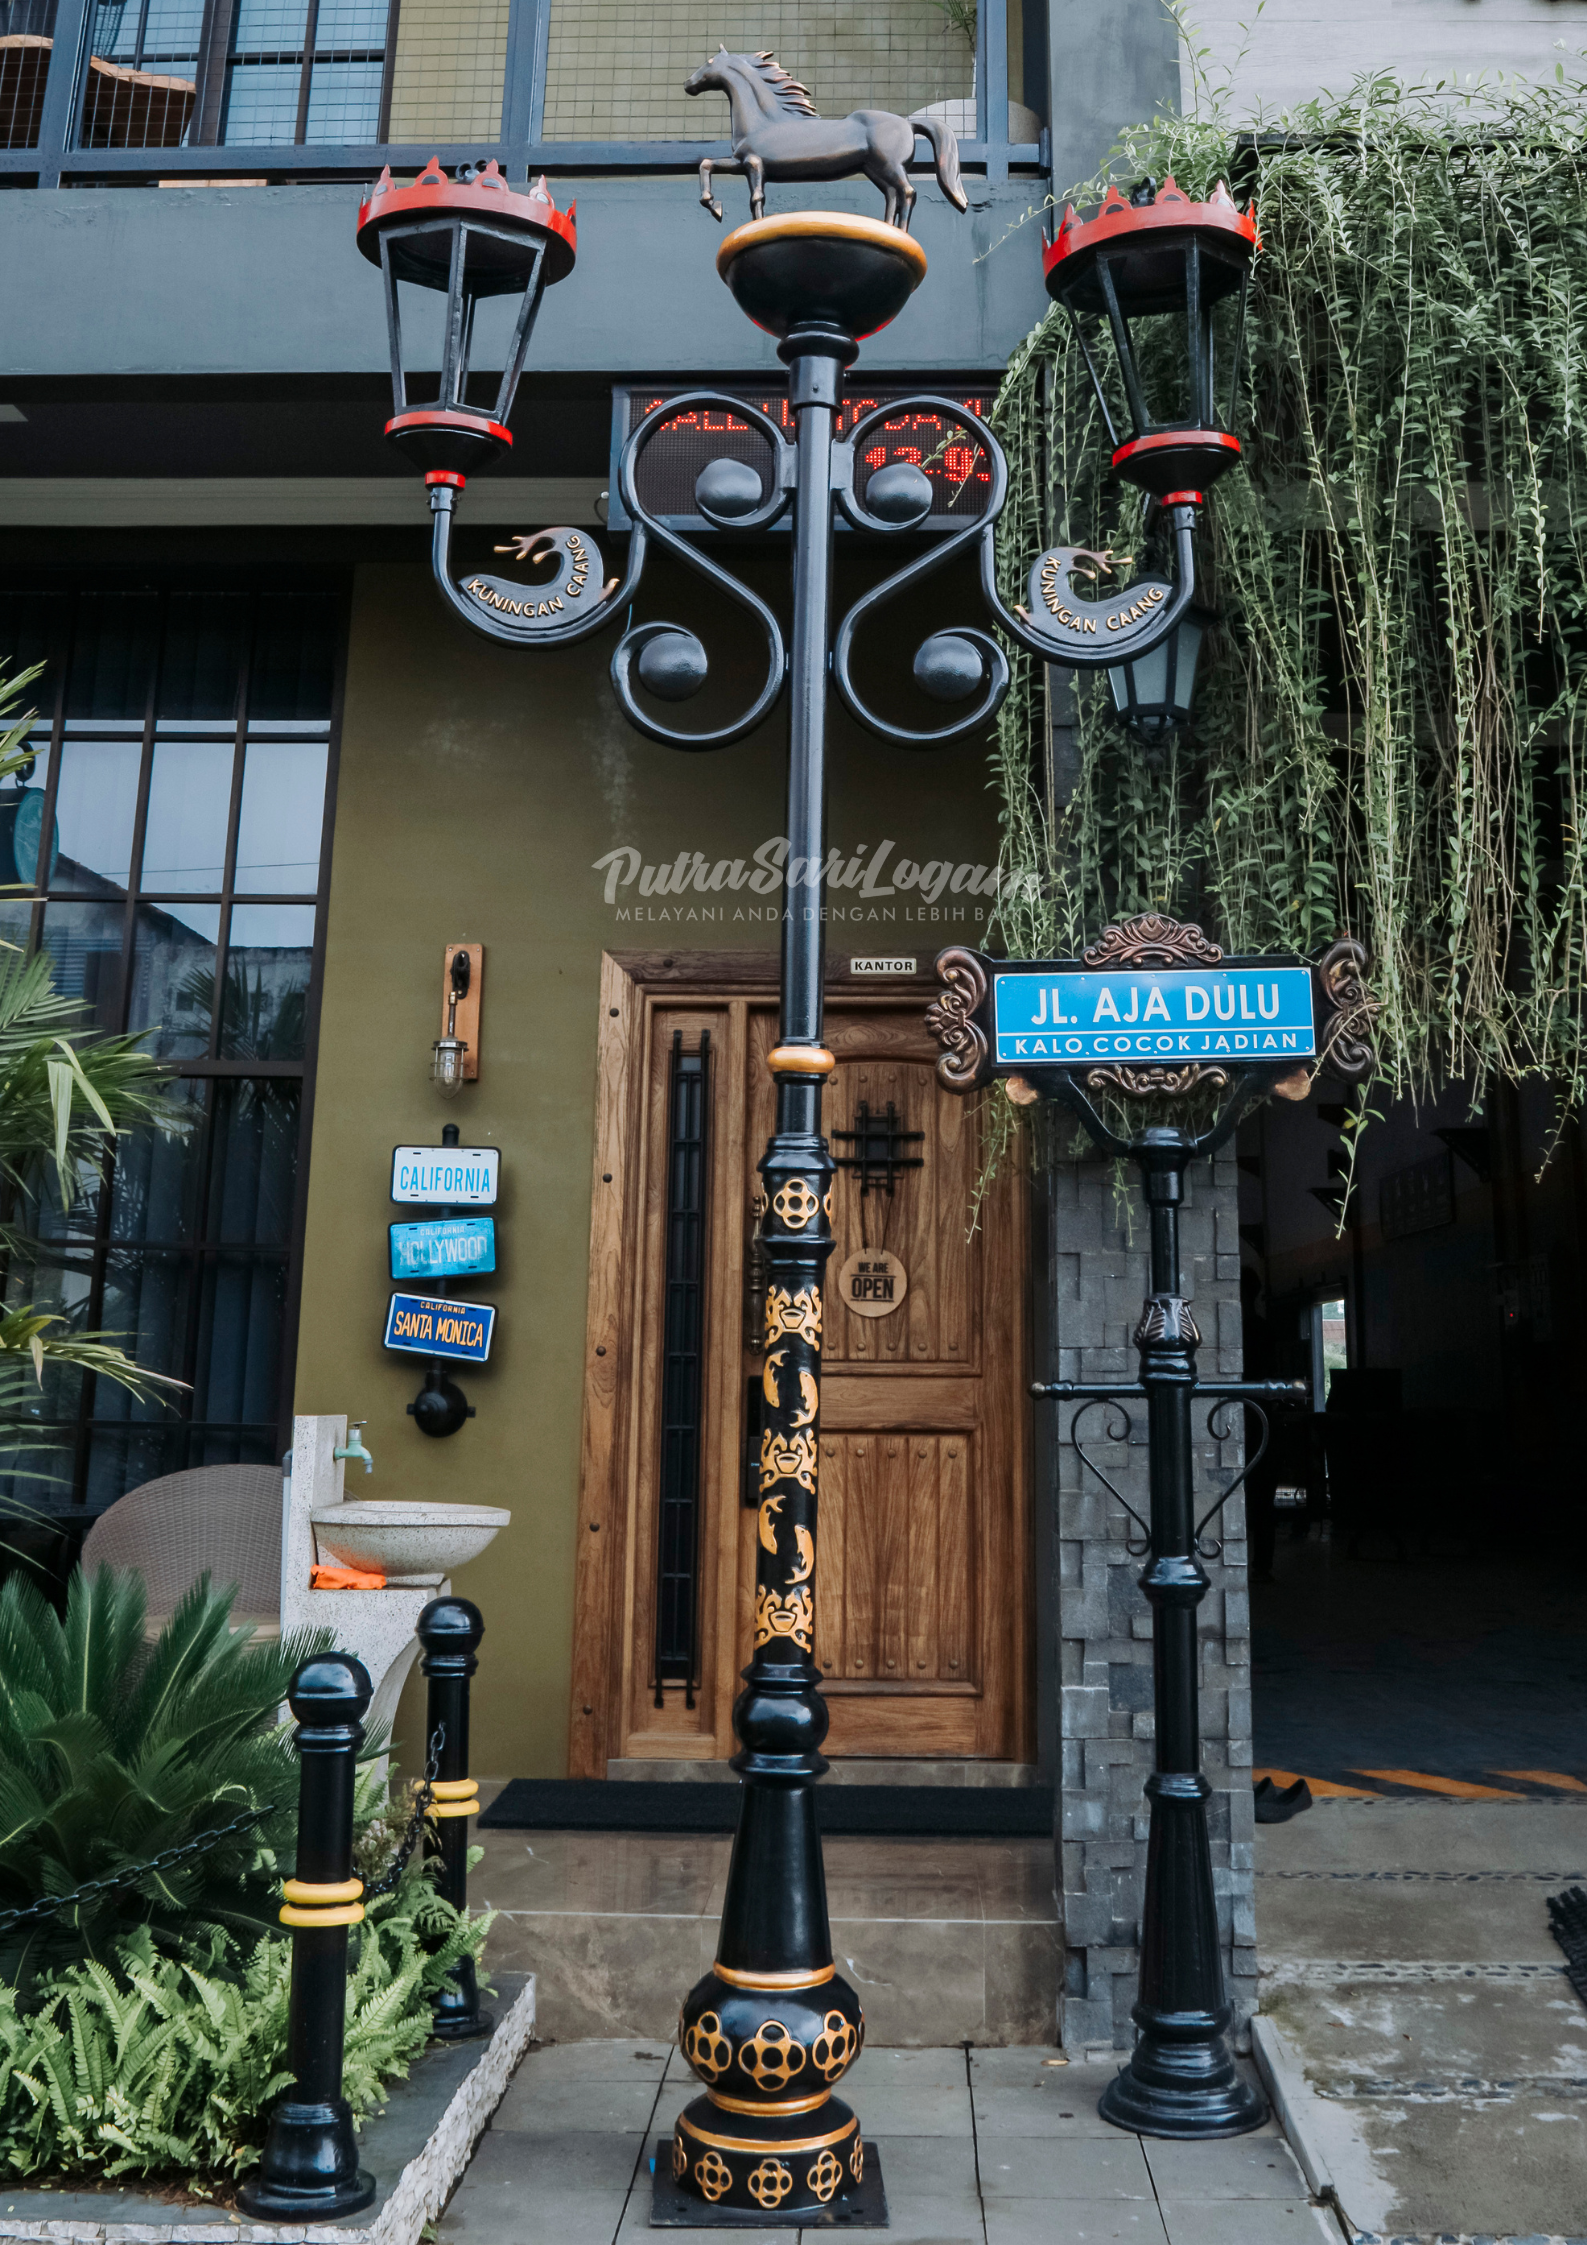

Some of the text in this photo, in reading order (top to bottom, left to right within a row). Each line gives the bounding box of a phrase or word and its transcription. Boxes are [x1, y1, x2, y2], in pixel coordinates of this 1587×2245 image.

[467, 535, 589, 617] KUNINGAN CAANG
[1041, 556, 1164, 633] KUNINGAN CAANG
[854, 960, 914, 972] KANTOR
[1030, 983, 1280, 1025] JL. AJA DULU
[1015, 1033, 1297, 1054] KALO COCOK JADIAN
[400, 1165, 491, 1193] CALIFORNIA
[420, 1226, 465, 1236] CALIFORNIA
[398, 1236, 488, 1266] HOLLYWOOD
[858, 1262, 889, 1273] WE ARE
[851, 1277, 895, 1299] OPEN
[420, 1301, 466, 1315] CALIFORNIA
[394, 1310, 484, 1348] SANTA MONICA
